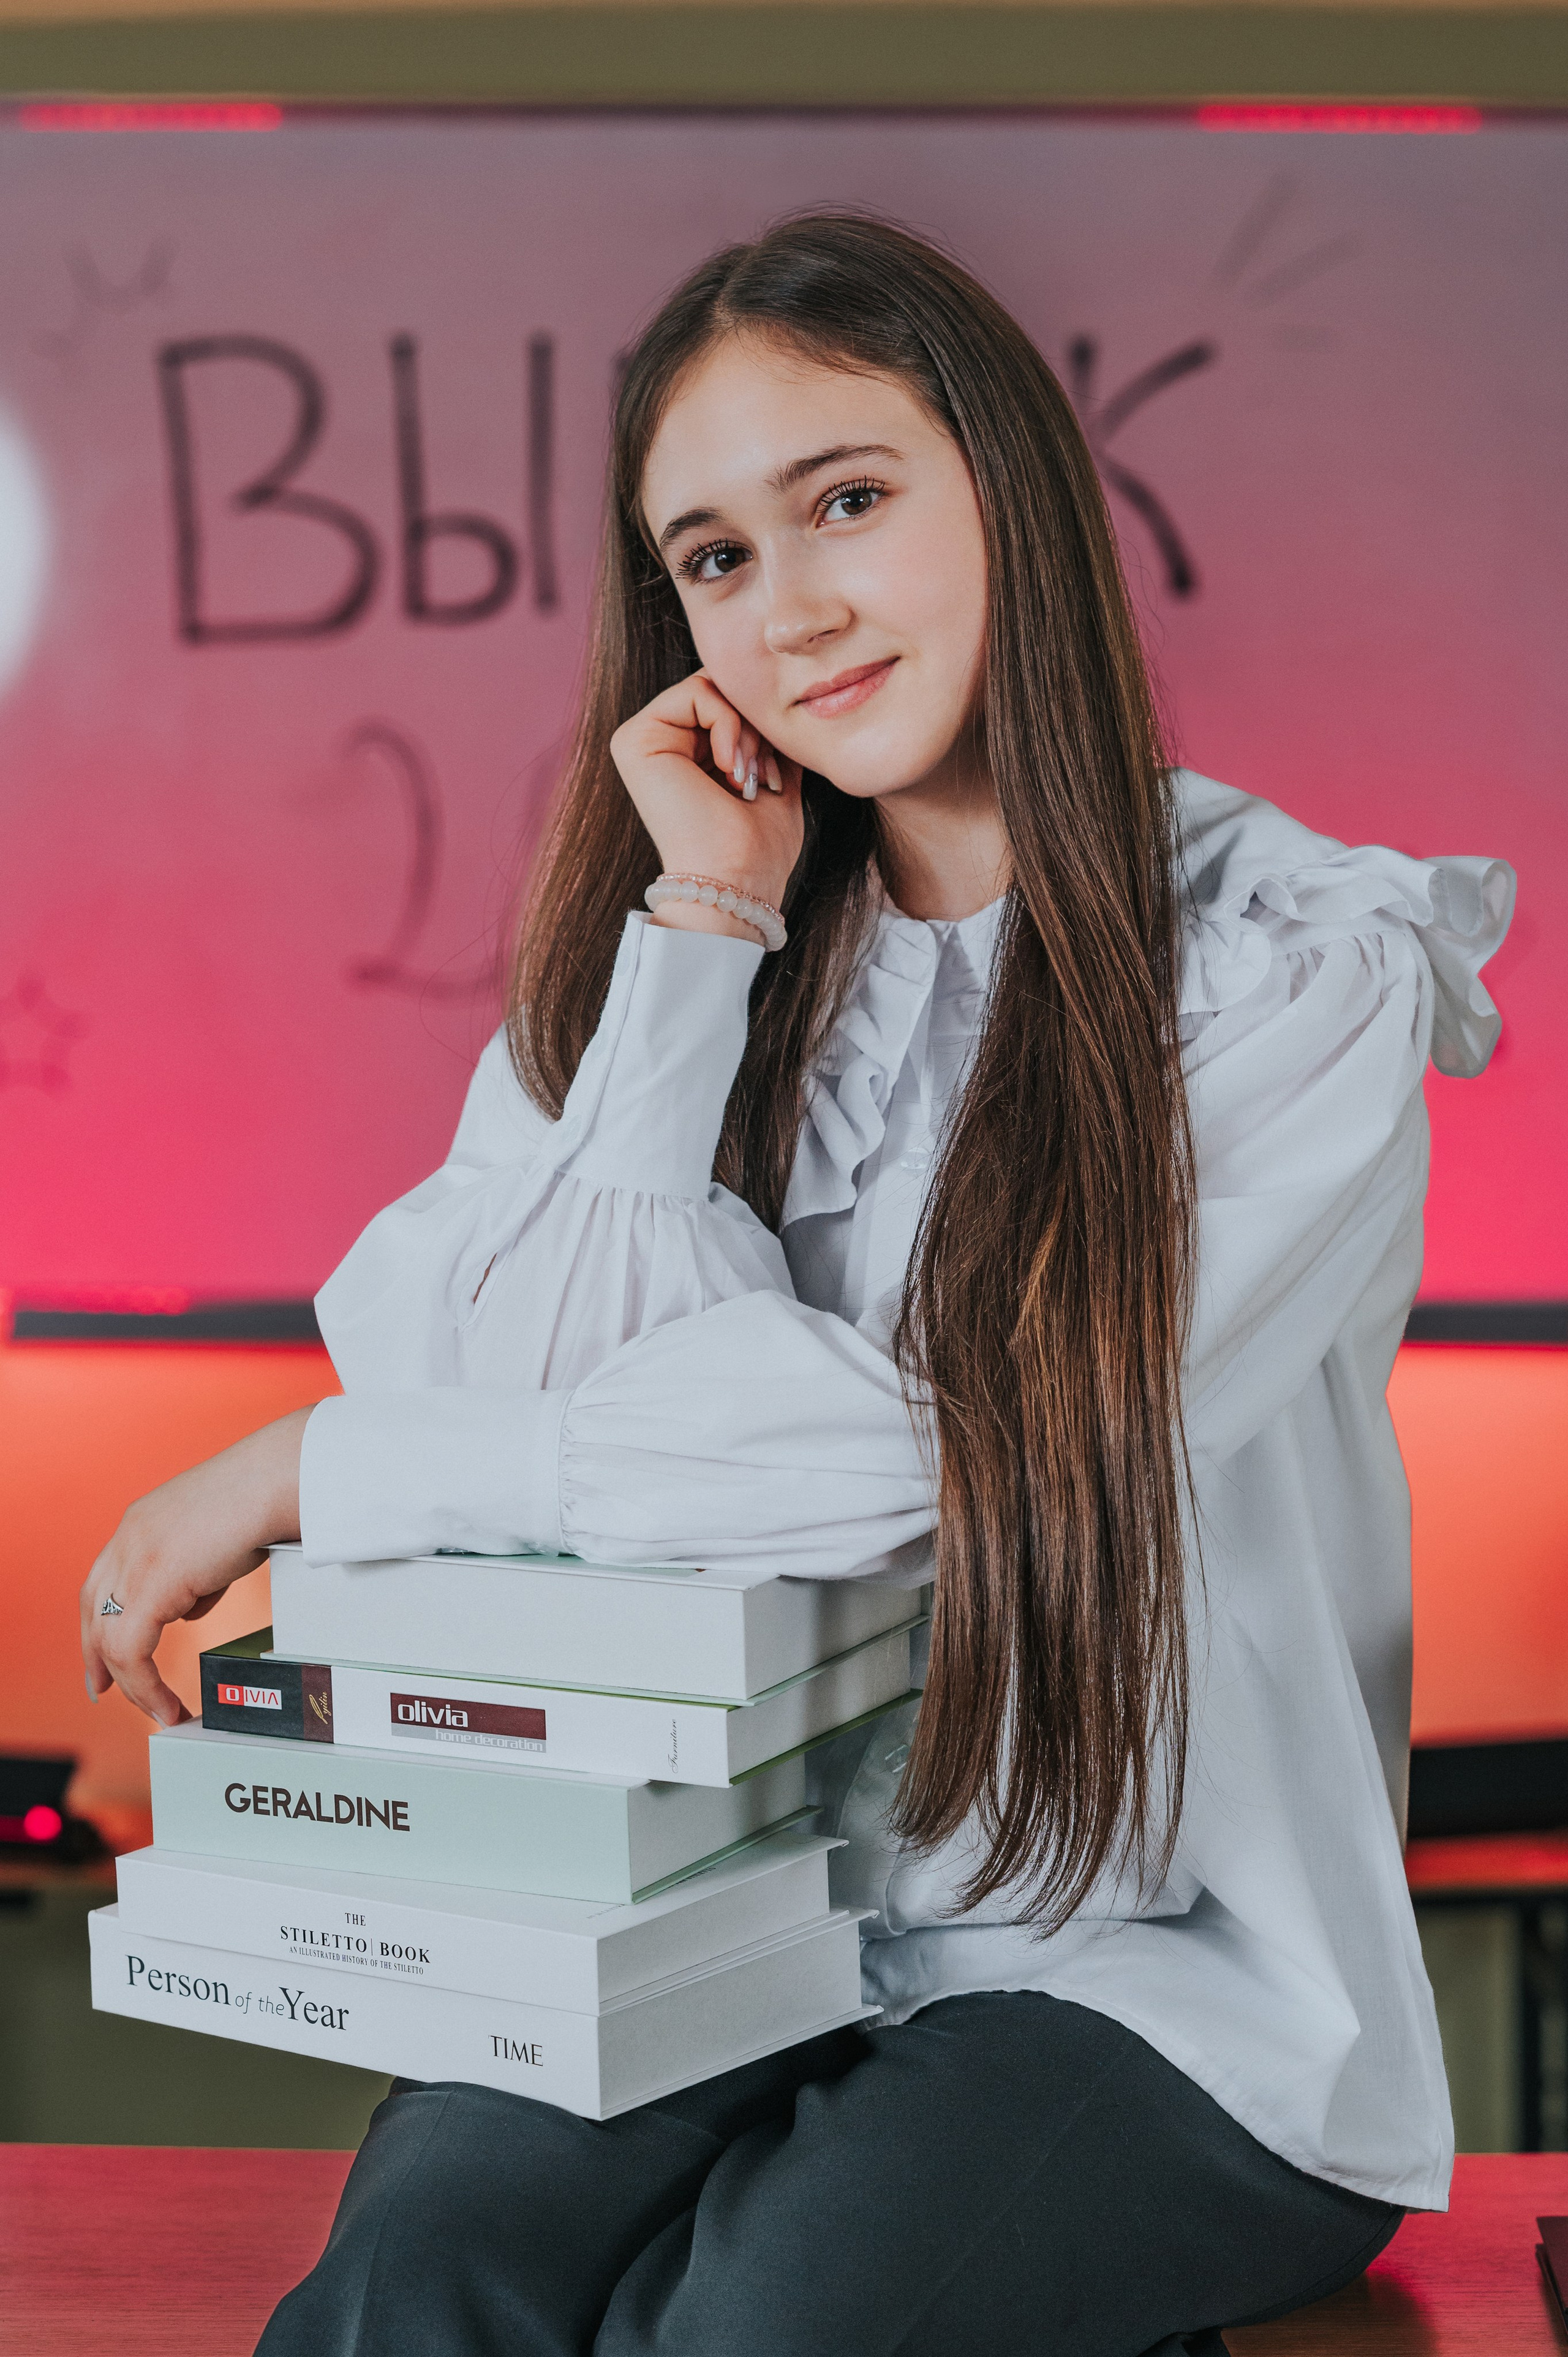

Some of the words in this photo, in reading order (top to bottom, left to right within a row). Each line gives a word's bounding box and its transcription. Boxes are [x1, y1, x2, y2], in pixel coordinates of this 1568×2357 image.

[398, 1700, 469, 1728] olivia
[435, 1729, 472, 1744] home
[474, 1734, 543, 1752] decoration
[668, 1719, 679, 1774] Furniture
[224, 1782, 410, 1832] GERALDINE
[344, 1912, 366, 1926] THE
[280, 1925, 367, 1953] STILETTO
[379, 1941, 431, 1964] BOOK
[299, 1947, 340, 1961] ILLUSTRATED
[342, 1954, 369, 1966] HISTORY
[370, 1959, 379, 1967] OF
[380, 1961, 392, 1970] THE
[393, 1962, 424, 1975] STILETTO
[125, 1954, 232, 2006] Person
[235, 1991, 252, 2015] of
[258, 1995, 285, 2016] the
[278, 1986, 350, 2031] Year
[488, 2035, 543, 2067] TIME
